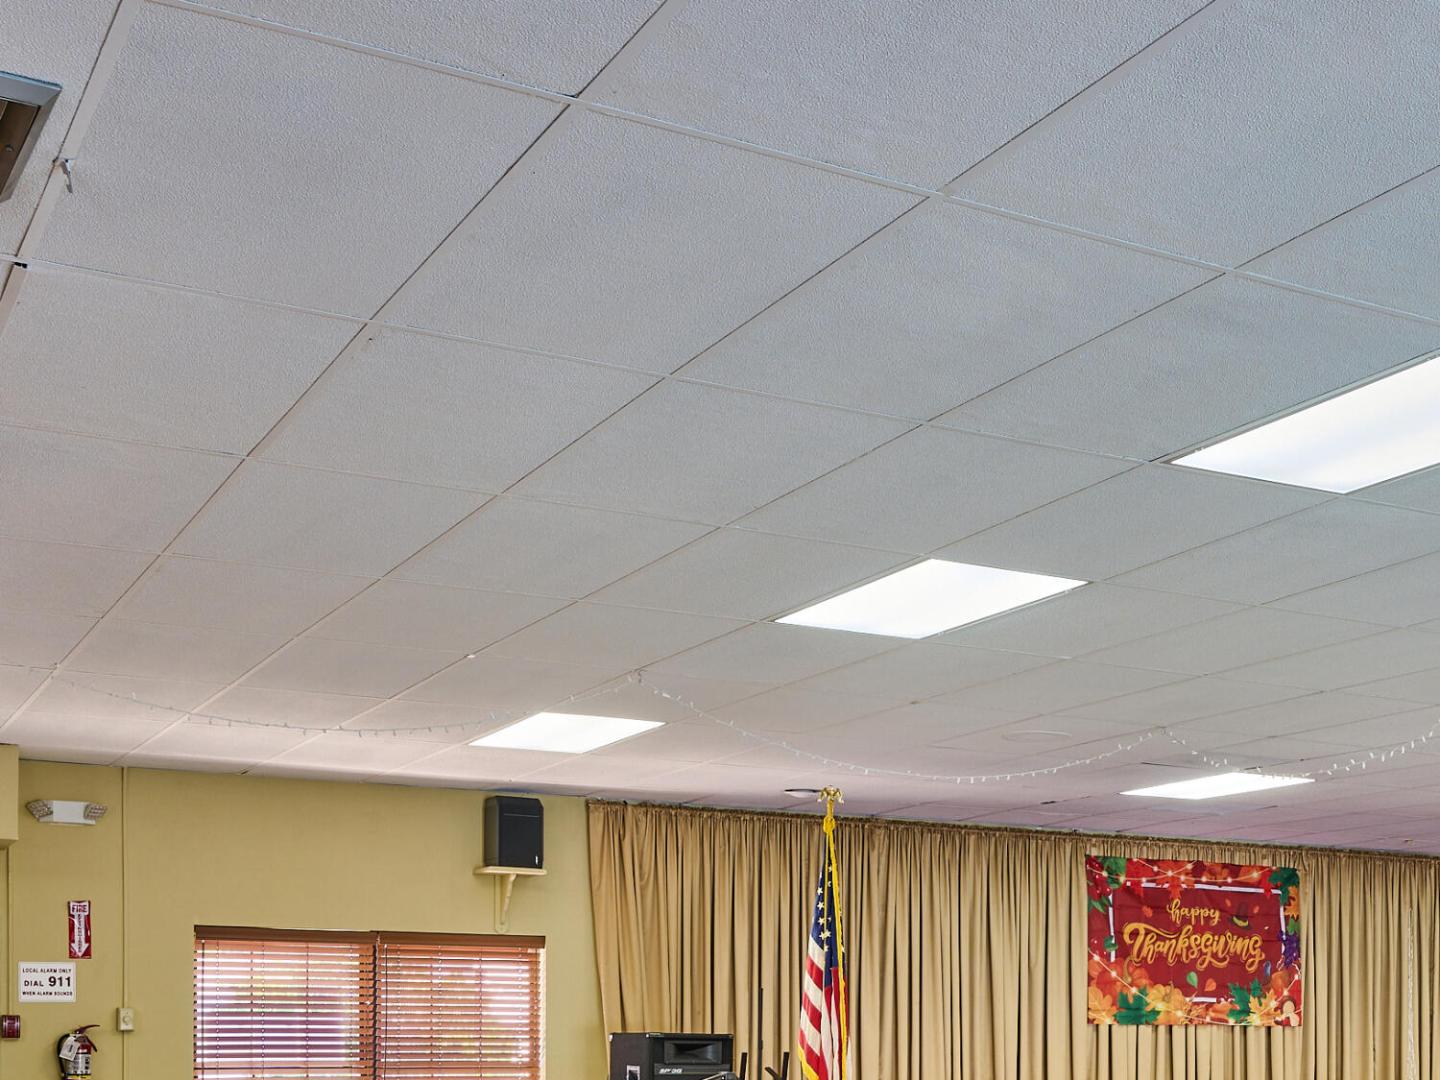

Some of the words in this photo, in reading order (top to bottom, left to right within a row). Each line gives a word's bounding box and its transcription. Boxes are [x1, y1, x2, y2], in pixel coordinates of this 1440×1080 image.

[72, 904, 87, 912] FIRE
[1167, 898, 1221, 925] happy
[1123, 922, 1265, 973] Thanksgiving
[48, 976, 71, 987] 911
